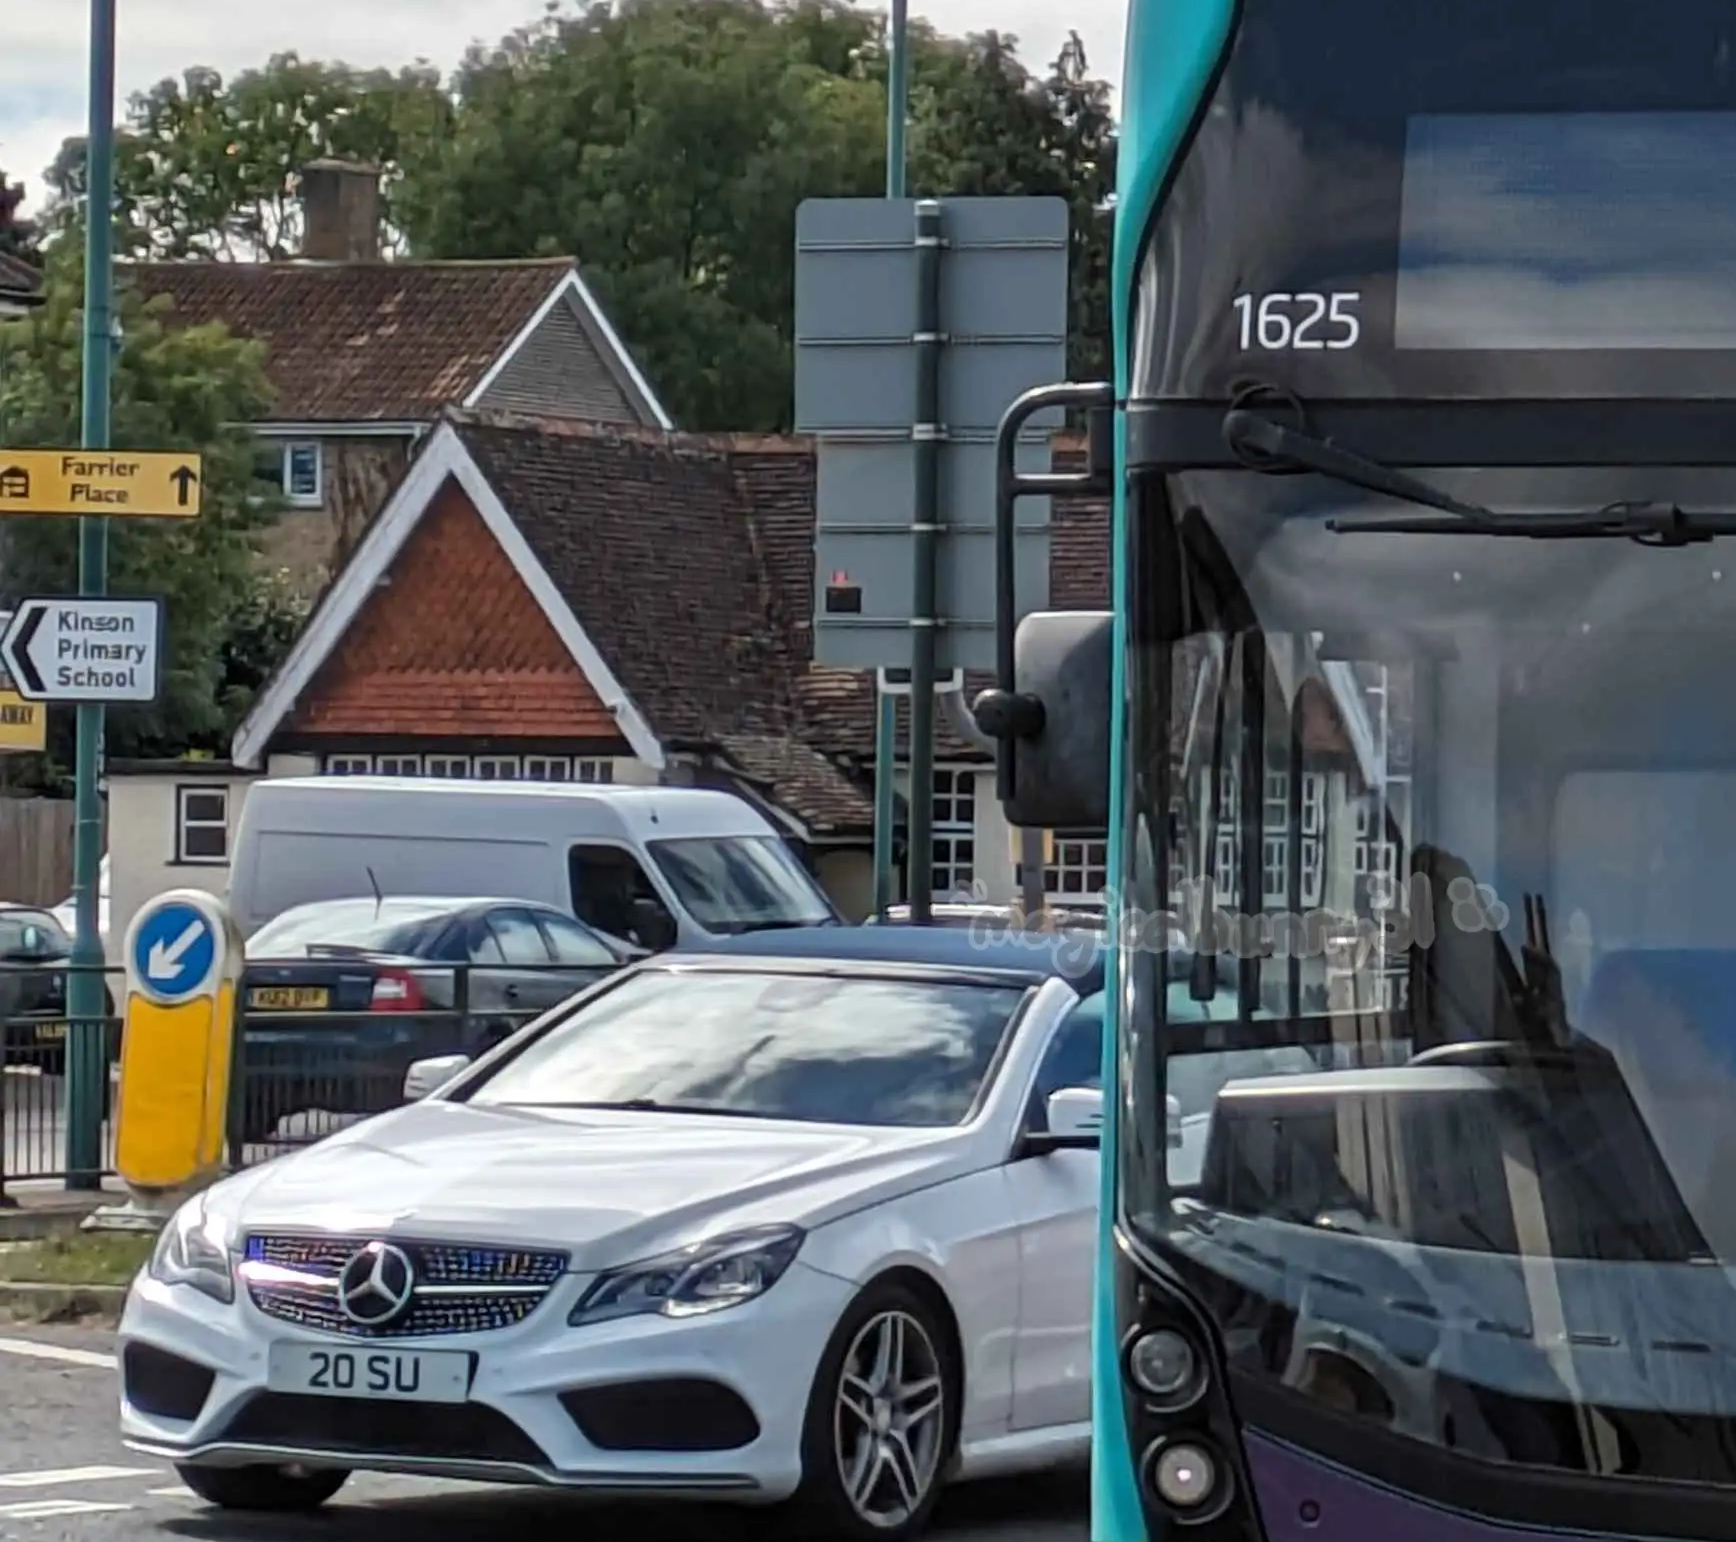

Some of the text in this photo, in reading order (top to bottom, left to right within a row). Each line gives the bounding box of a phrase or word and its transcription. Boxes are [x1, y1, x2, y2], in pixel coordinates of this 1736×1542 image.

[1233, 292, 1360, 350] 1625
[61, 456, 140, 477] Farrier
[70, 483, 129, 504] Place
[59, 610, 134, 633] Kinson
[58, 638, 147, 665] Primary
[57, 665, 136, 688] School
[308, 1351, 420, 1393] 20 SU
